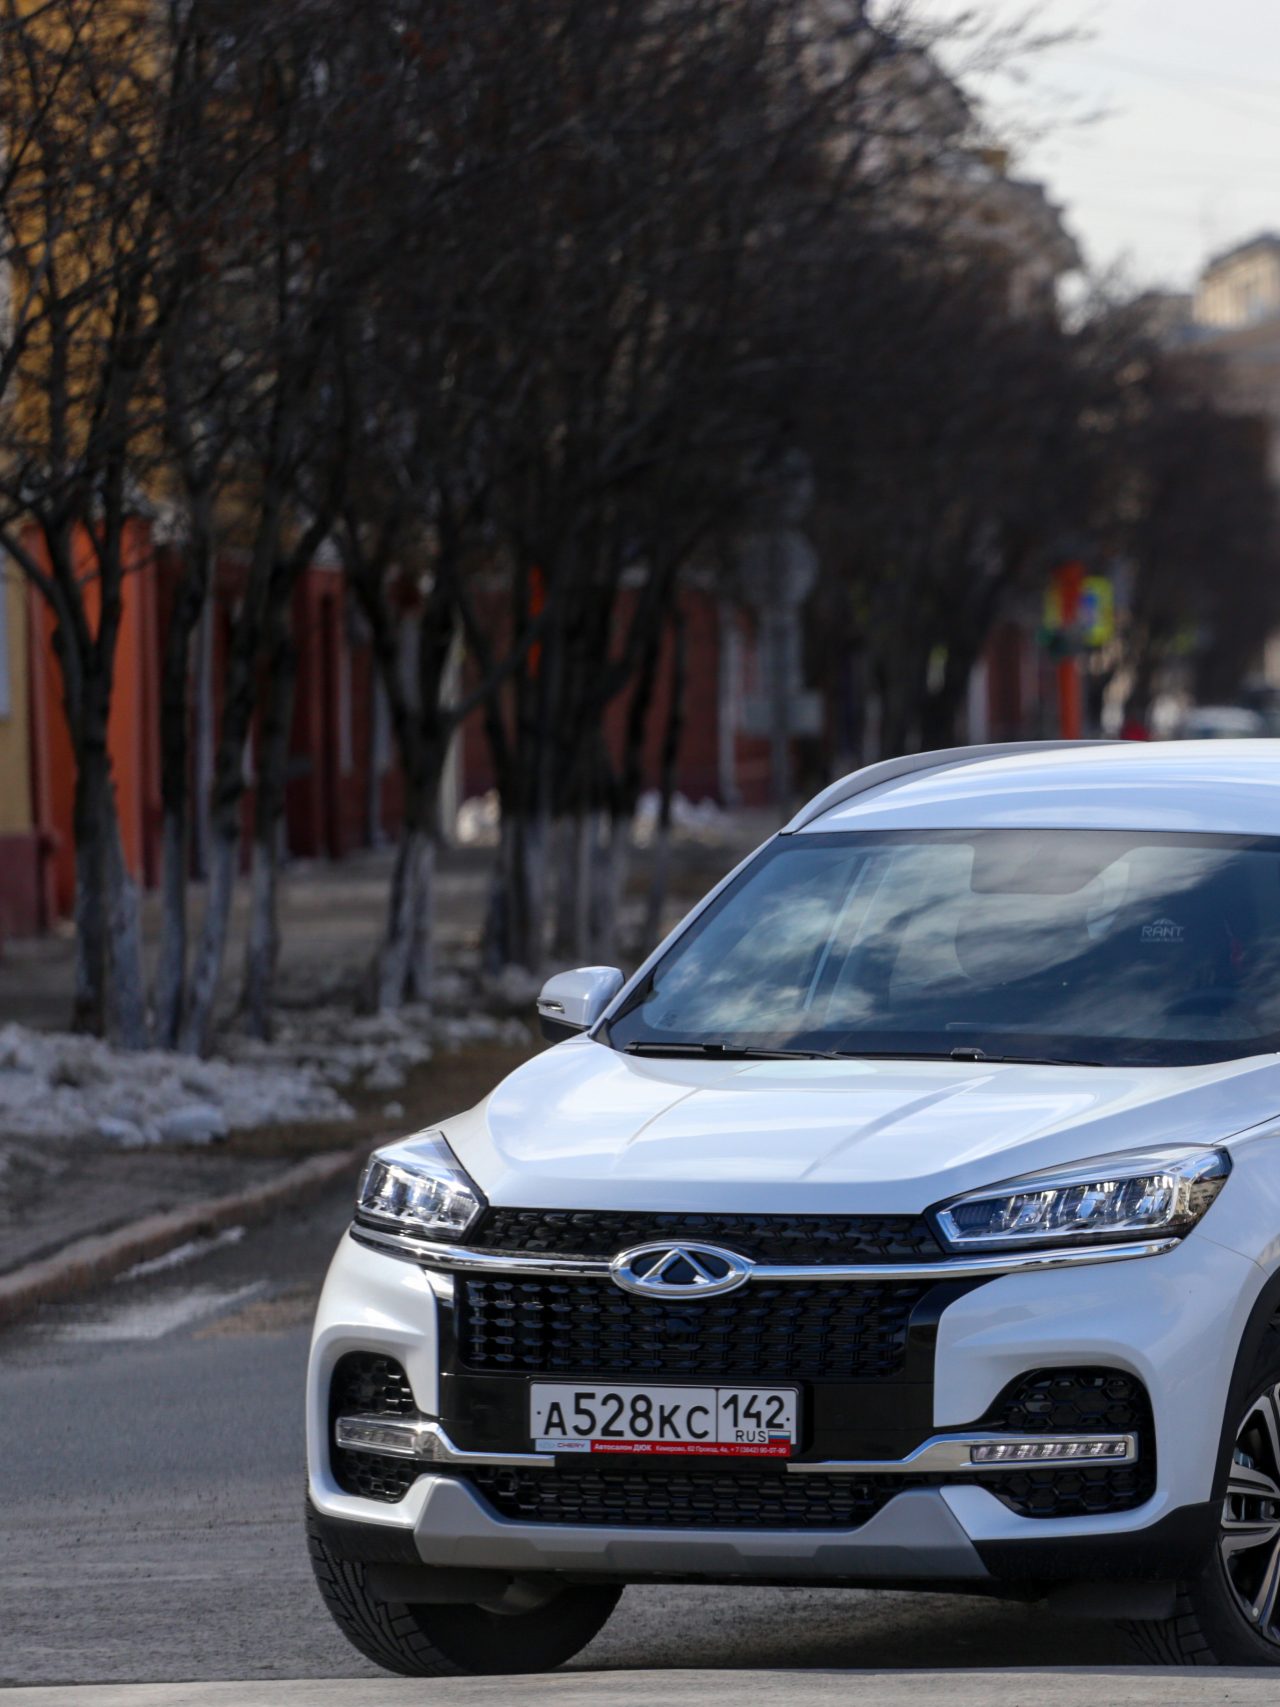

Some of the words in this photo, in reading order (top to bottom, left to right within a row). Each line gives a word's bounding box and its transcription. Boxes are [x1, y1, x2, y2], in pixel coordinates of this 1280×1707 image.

[1141, 926, 1184, 937] RANT
[722, 1394, 785, 1430] 142
[735, 1430, 766, 1443] RUS
